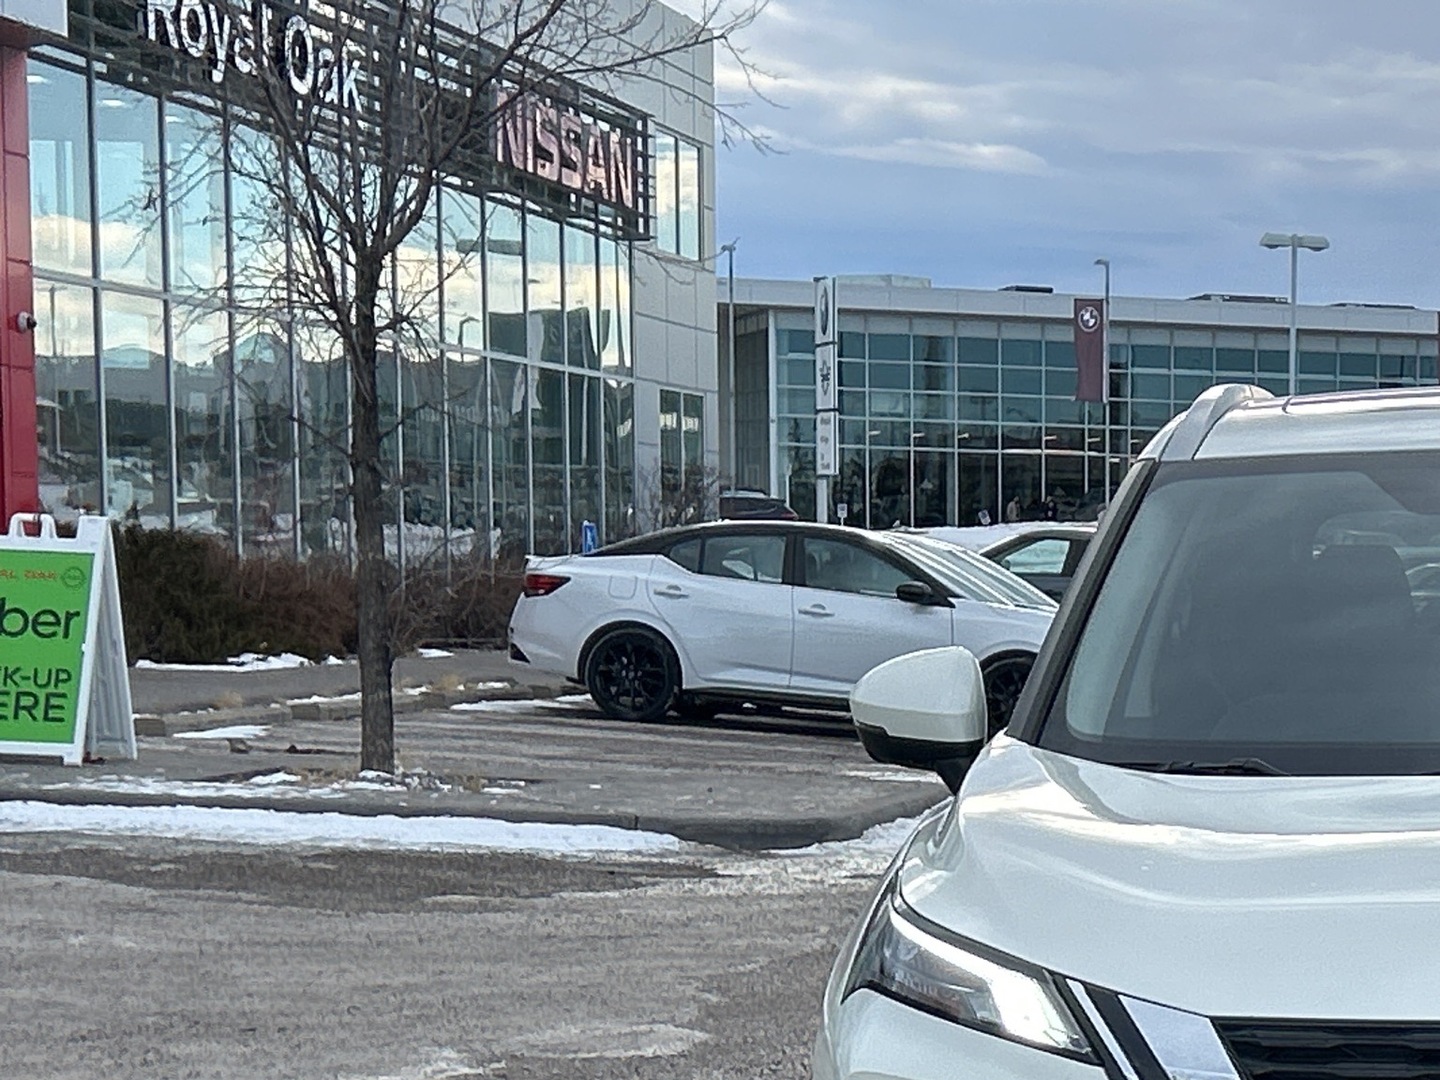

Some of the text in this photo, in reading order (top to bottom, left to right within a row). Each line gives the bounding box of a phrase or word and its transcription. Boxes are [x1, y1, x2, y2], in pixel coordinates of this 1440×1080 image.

[285, 14, 363, 113] Oak
[495, 82, 633, 208] NISSAN
[0, 666, 72, 689] K-UP
